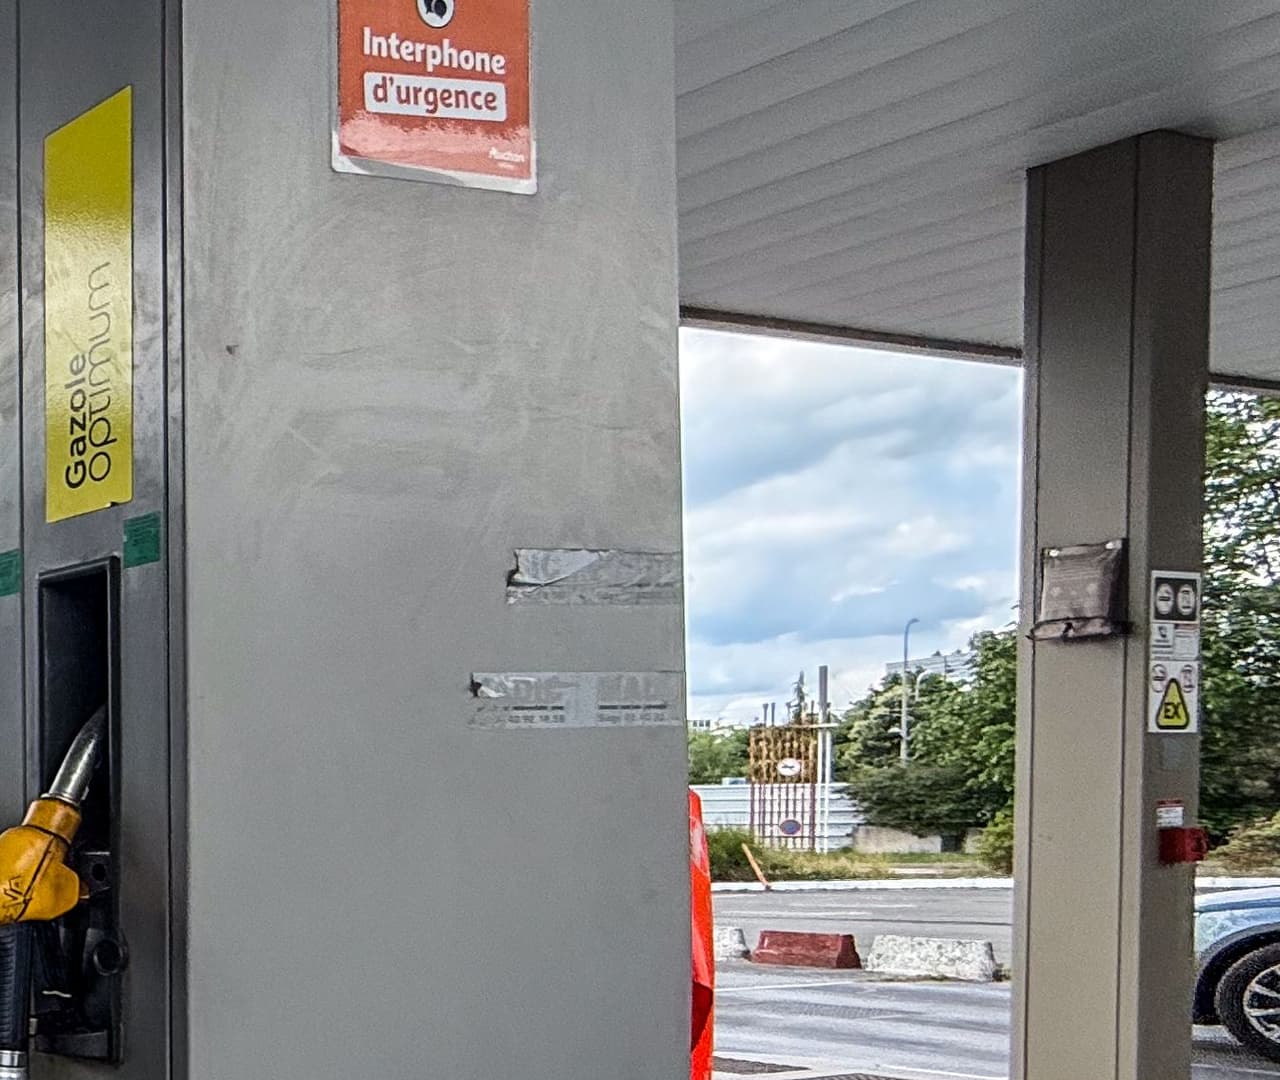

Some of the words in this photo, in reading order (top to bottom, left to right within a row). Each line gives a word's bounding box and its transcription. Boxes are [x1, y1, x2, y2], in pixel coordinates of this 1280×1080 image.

[363, 26, 506, 75] Interphone
[372, 76, 498, 115] d'urgence
[88, 262, 118, 482] optimum
[64, 353, 87, 489] Gazole
[1163, 702, 1182, 720] EX
